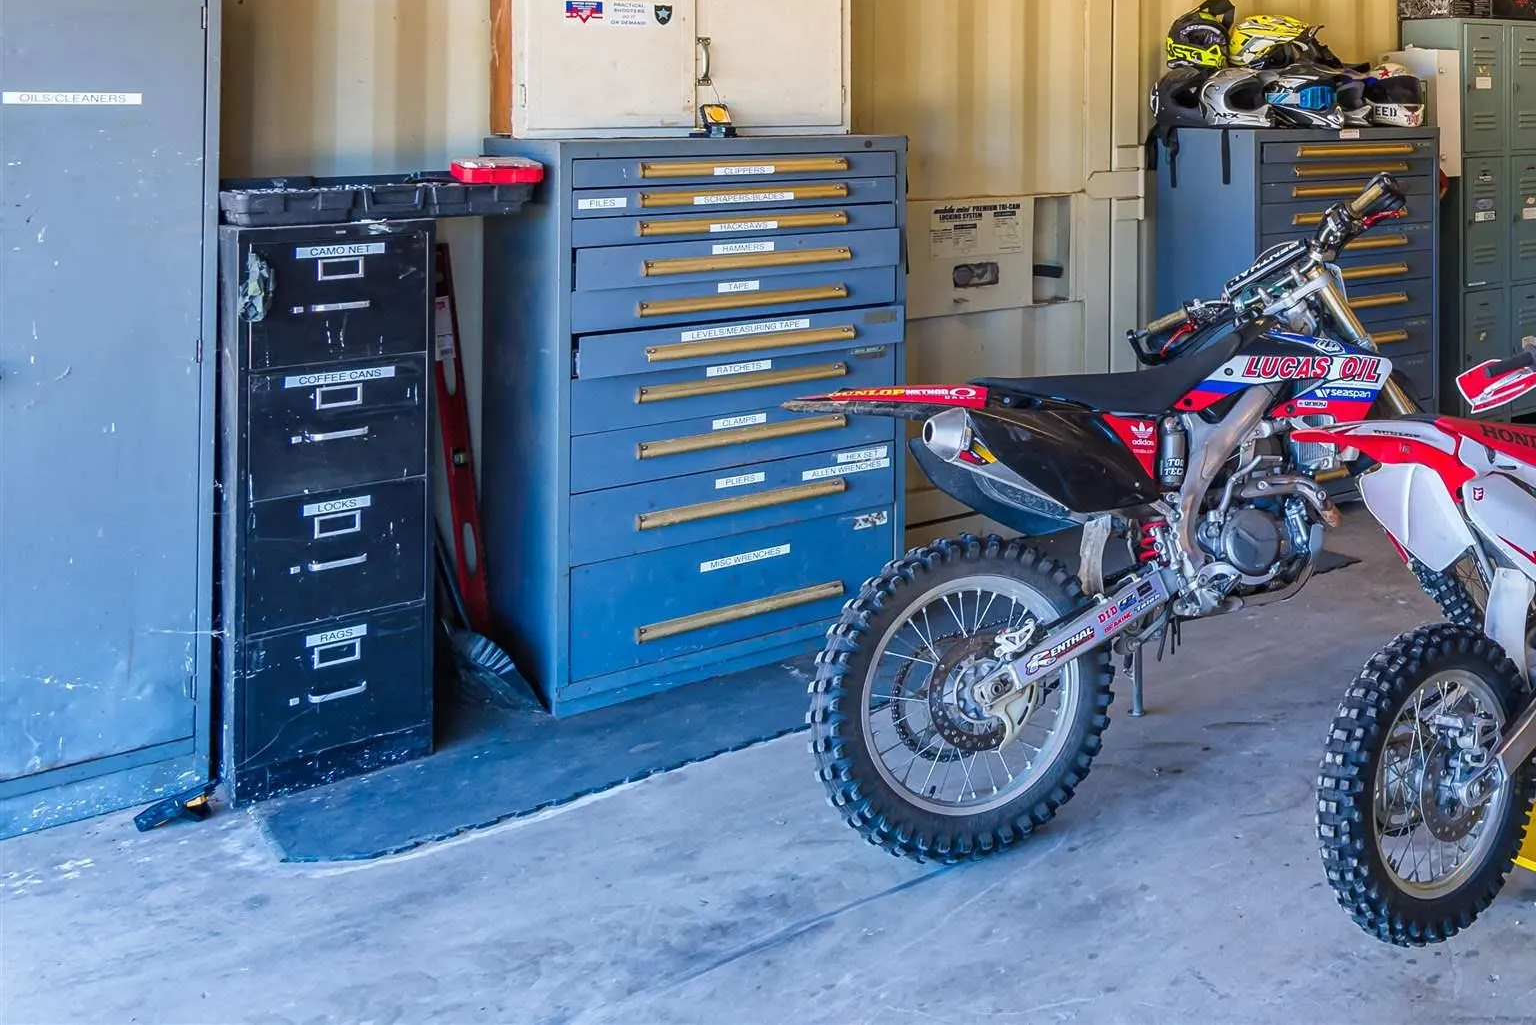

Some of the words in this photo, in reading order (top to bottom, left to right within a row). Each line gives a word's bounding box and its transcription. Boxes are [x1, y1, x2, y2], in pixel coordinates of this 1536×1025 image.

[19, 93, 127, 103] OILS/CLEANERS
[723, 166, 766, 175] CLIPPERS
[703, 191, 785, 204] SCRAPERS/BLADES
[589, 199, 616, 208] FILES
[972, 203, 997, 212] PREMIUM
[719, 221, 768, 231] HACKSAWS
[310, 246, 345, 256] CAMO
[349, 244, 370, 254] NET
[722, 243, 765, 253] HAMMERS
[728, 282, 749, 290] TAPE
[691, 322, 777, 339] LEVELS/MEASURING
[779, 320, 800, 329] TAPE
[716, 362, 762, 375] RATCHETS
[1243, 355, 1334, 379] LUCAS
[1339, 356, 1382, 383] OIL
[298, 371, 347, 385] COFFEE
[350, 369, 382, 380] CANS
[828, 388, 906, 398] DUNLOP
[1330, 388, 1371, 399] seaspan
[722, 416, 757, 427] CLAMPS
[1131, 438, 1155, 446] adidas
[846, 450, 863, 460] HEX
[863, 449, 879, 458] SET
[811, 466, 836, 477] ALLEN
[838, 460, 882, 473] WRENCHES
[725, 475, 756, 486] PLIERS
[317, 498, 357, 513] LOCKS
[710, 558, 732, 569] MISC
[733, 547, 781, 563] WRENCHES
[320, 628, 353, 643] RAGS
[1025, 625, 1095, 676] RENTHAL
